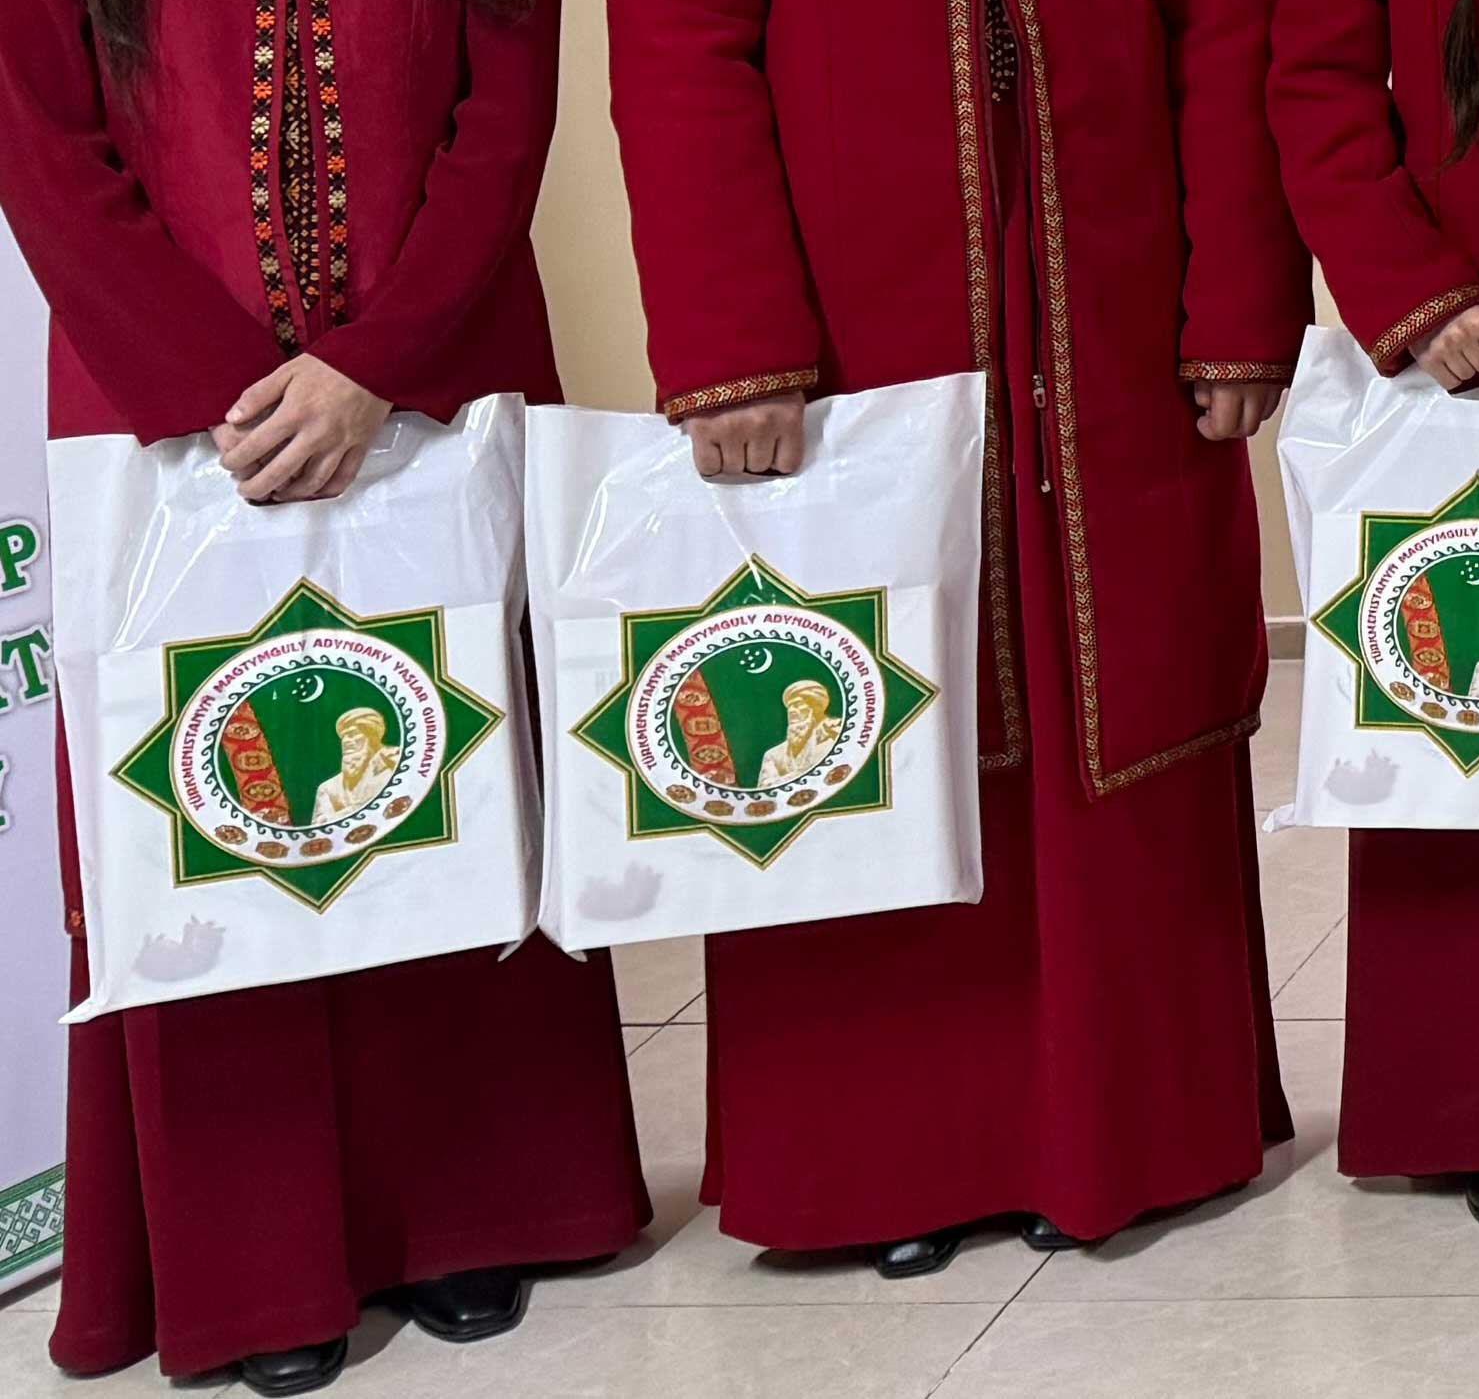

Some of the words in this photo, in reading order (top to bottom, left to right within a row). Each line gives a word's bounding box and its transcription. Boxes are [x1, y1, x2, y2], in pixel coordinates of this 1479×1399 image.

[1397, 527, 1477, 563] MAGTYMGULY
[211, 641, 307, 693] MAGTYMGULY
[416, 706, 436, 778] GURAMASY
[664, 614, 754, 662] MAGTYMGULY
[855, 680, 876, 748] GURAMASY
